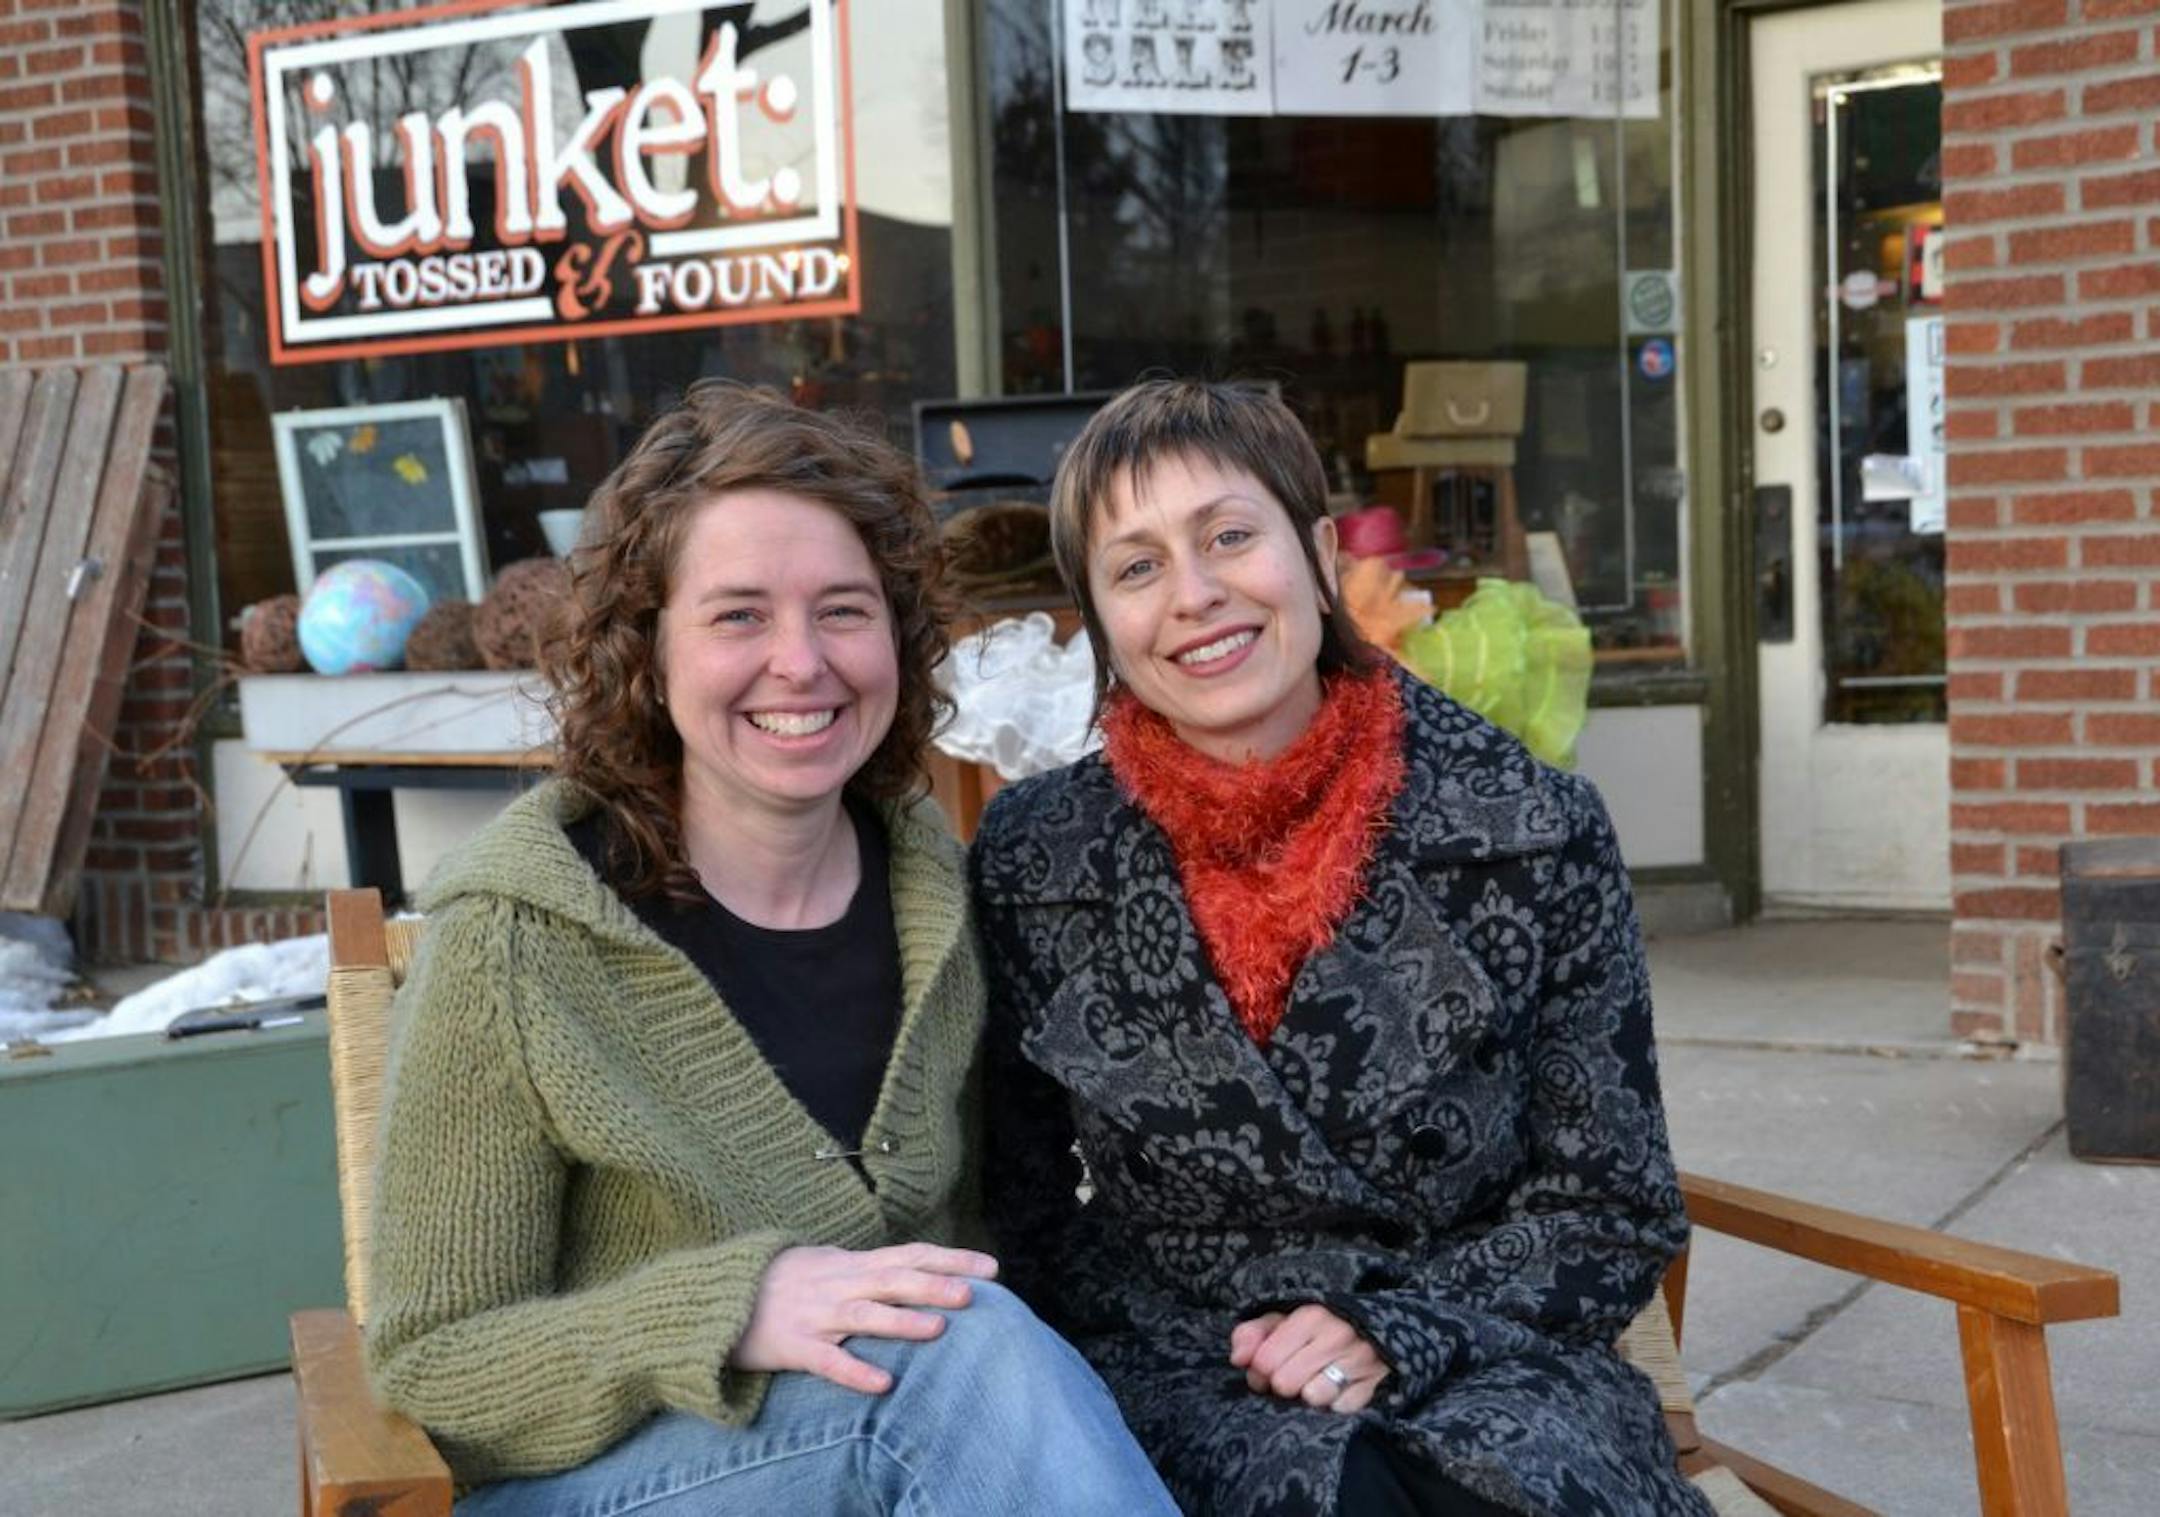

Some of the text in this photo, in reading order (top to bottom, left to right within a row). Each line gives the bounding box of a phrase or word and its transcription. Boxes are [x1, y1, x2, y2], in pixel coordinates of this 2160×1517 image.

[1304, 0, 1438, 35] March
[1082, 33, 1256, 90] SALE
[1339, 44, 1400, 84] 1-3
[351, 229, 838, 320] TOSSED & FOUND
